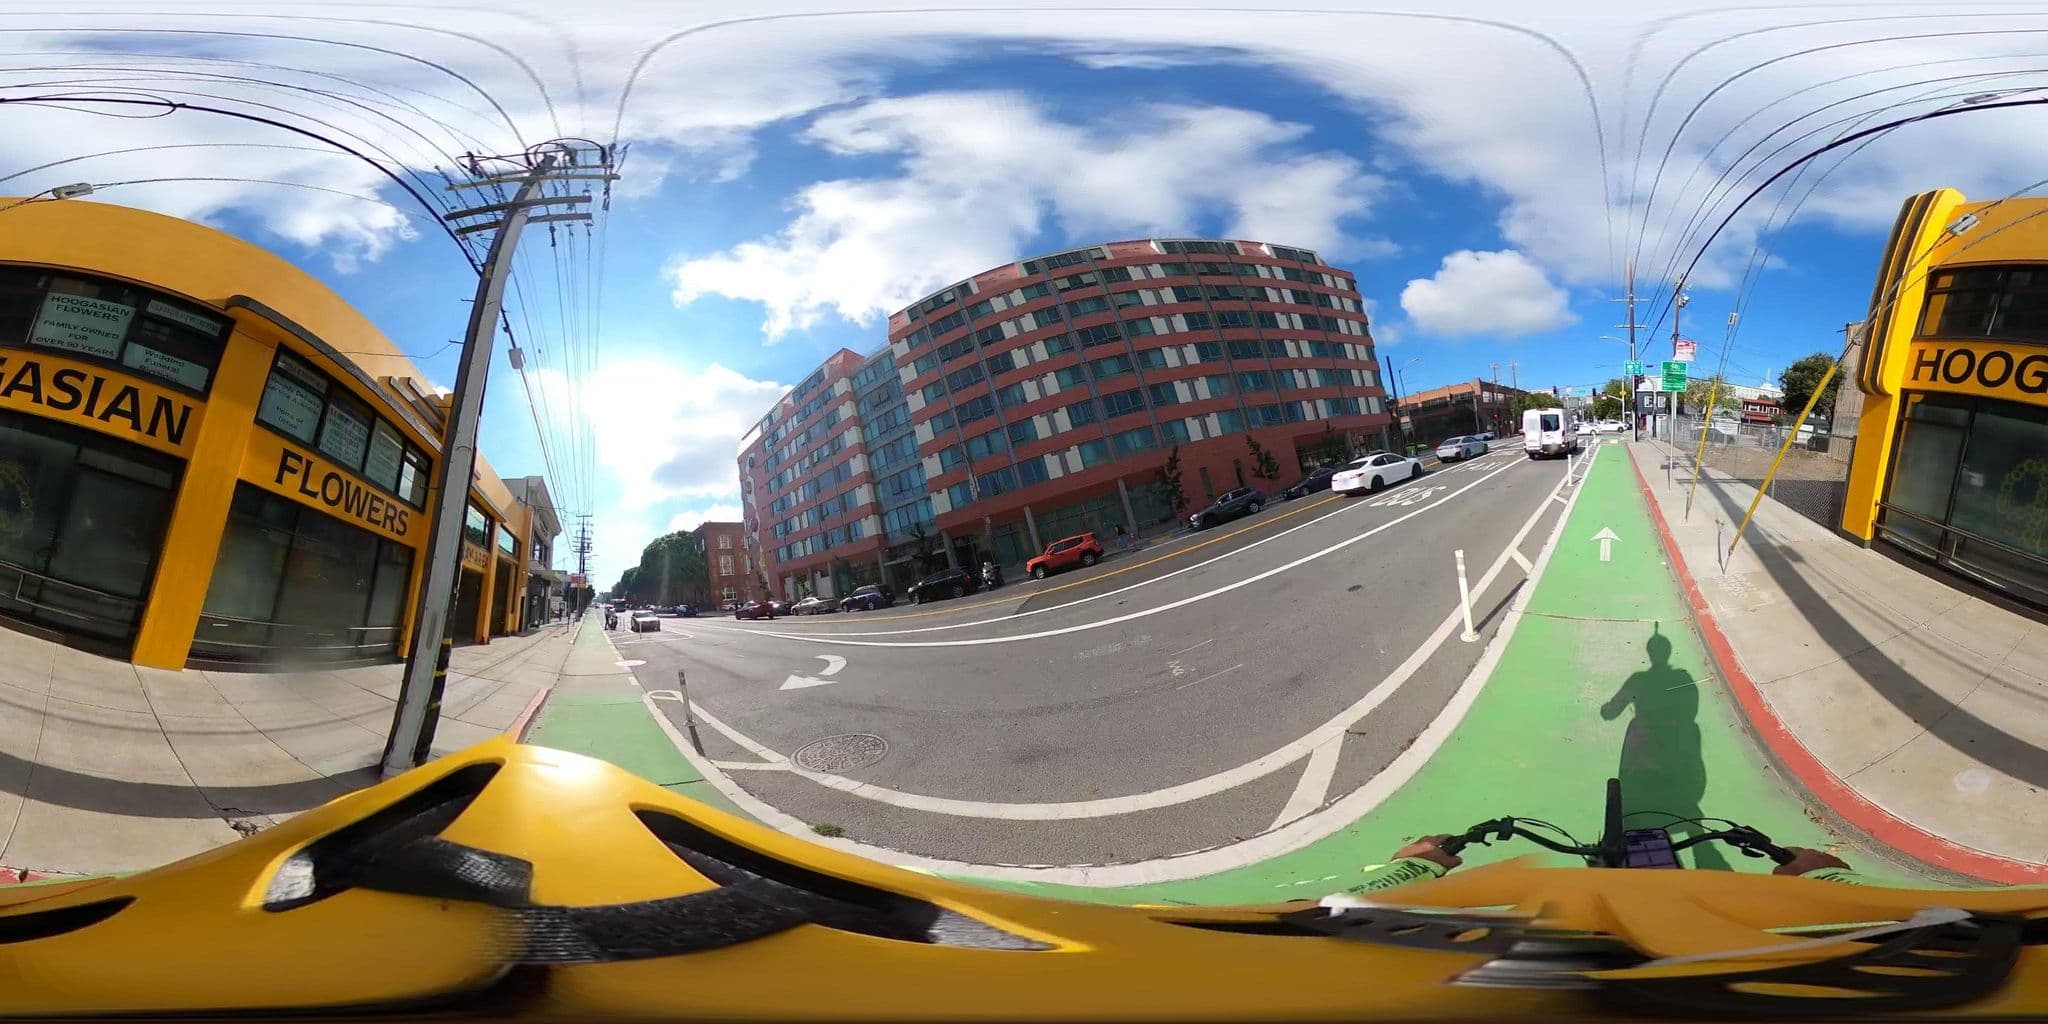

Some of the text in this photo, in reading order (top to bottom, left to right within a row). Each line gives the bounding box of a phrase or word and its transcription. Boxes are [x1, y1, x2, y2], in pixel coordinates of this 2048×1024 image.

[51, 296, 130, 316] HOOGASIAN
[56, 304, 119, 322] FLOWERS
[43, 320, 119, 340] FAMILY OWNED
[68, 333, 88, 341] FOR
[36, 337, 64, 346] OVER
[80, 344, 115, 357] YEARS
[144, 349, 186, 367] Wedding
[144, 358, 181, 374] Funeral
[0, 356, 193, 446] ASIAN
[275, 447, 409, 537] FLOWERS
